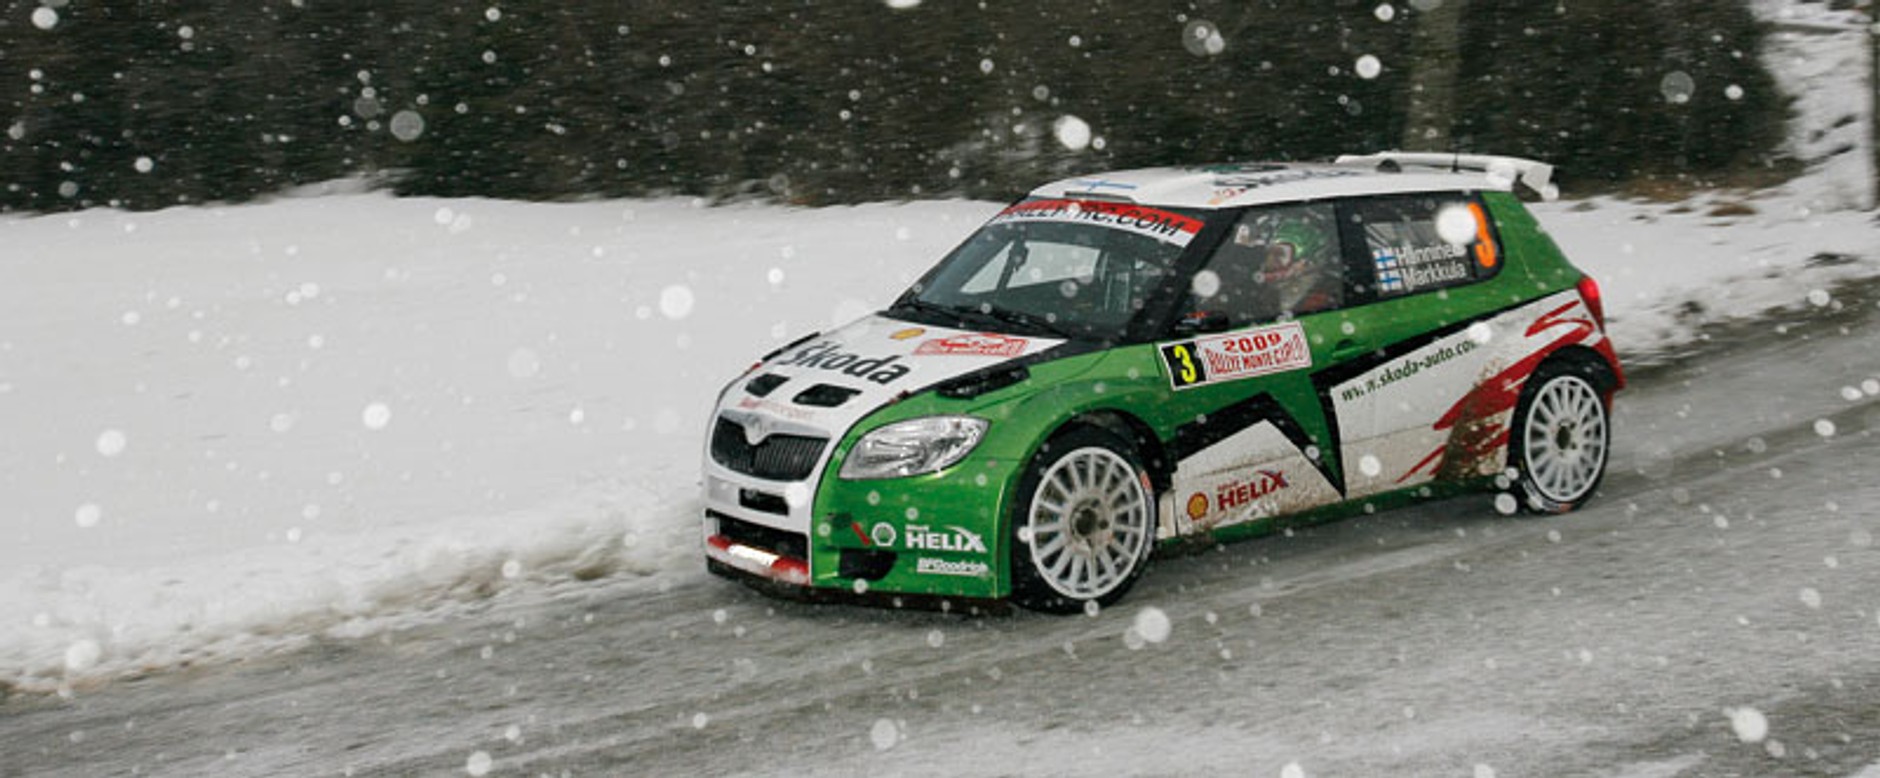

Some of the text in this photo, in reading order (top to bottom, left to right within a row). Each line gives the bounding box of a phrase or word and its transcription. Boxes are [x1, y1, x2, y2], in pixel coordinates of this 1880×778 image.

[1466, 202, 1497, 268] 3
[1401, 261, 1467, 292] Markkula
[1222, 332, 1282, 353] 2009
[1241, 350, 1274, 371] MONTE
[1274, 333, 1304, 366] CARLO
[1173, 345, 1196, 383] 3
[1217, 470, 1289, 512] HELIX
[905, 527, 988, 554] HELIX
